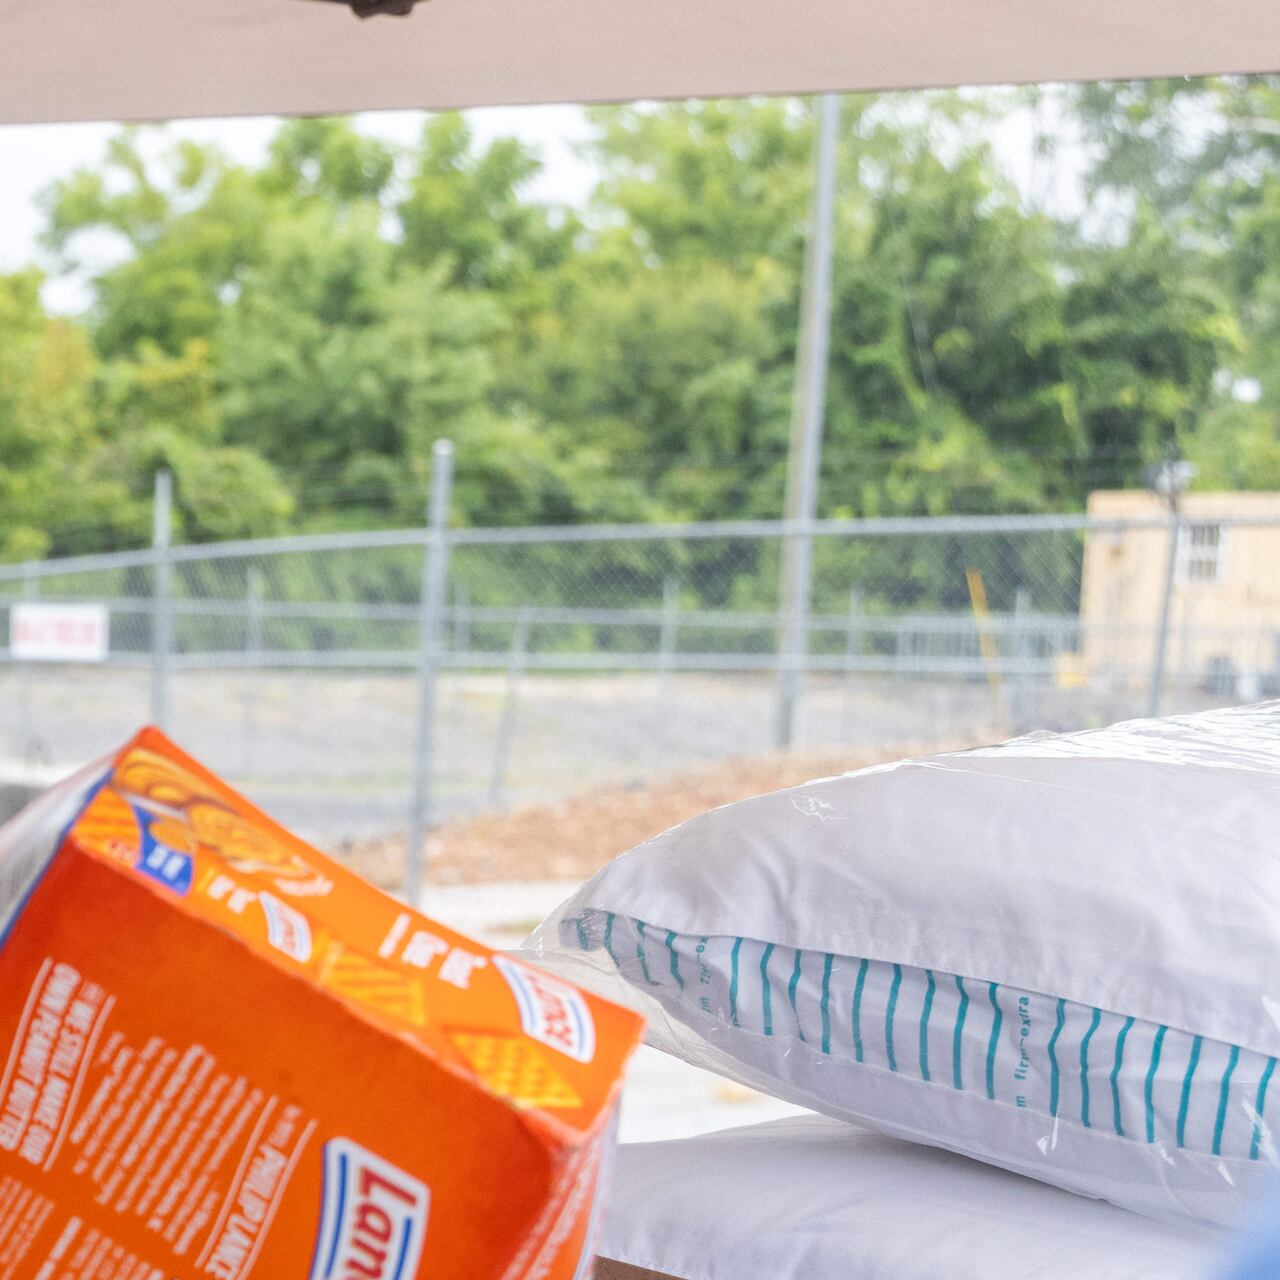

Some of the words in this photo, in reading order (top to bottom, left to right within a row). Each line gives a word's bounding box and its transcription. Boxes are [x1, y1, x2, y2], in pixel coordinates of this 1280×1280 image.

[38, 959, 83, 1016] OWN
[14, 1005, 62, 1088] PEANUT
[47, 1026, 86, 1081] STILL
[30, 1073, 73, 1132] MAKE
[15, 1122, 53, 1168] OUR
[230, 1141, 290, 1224] PHILIP
